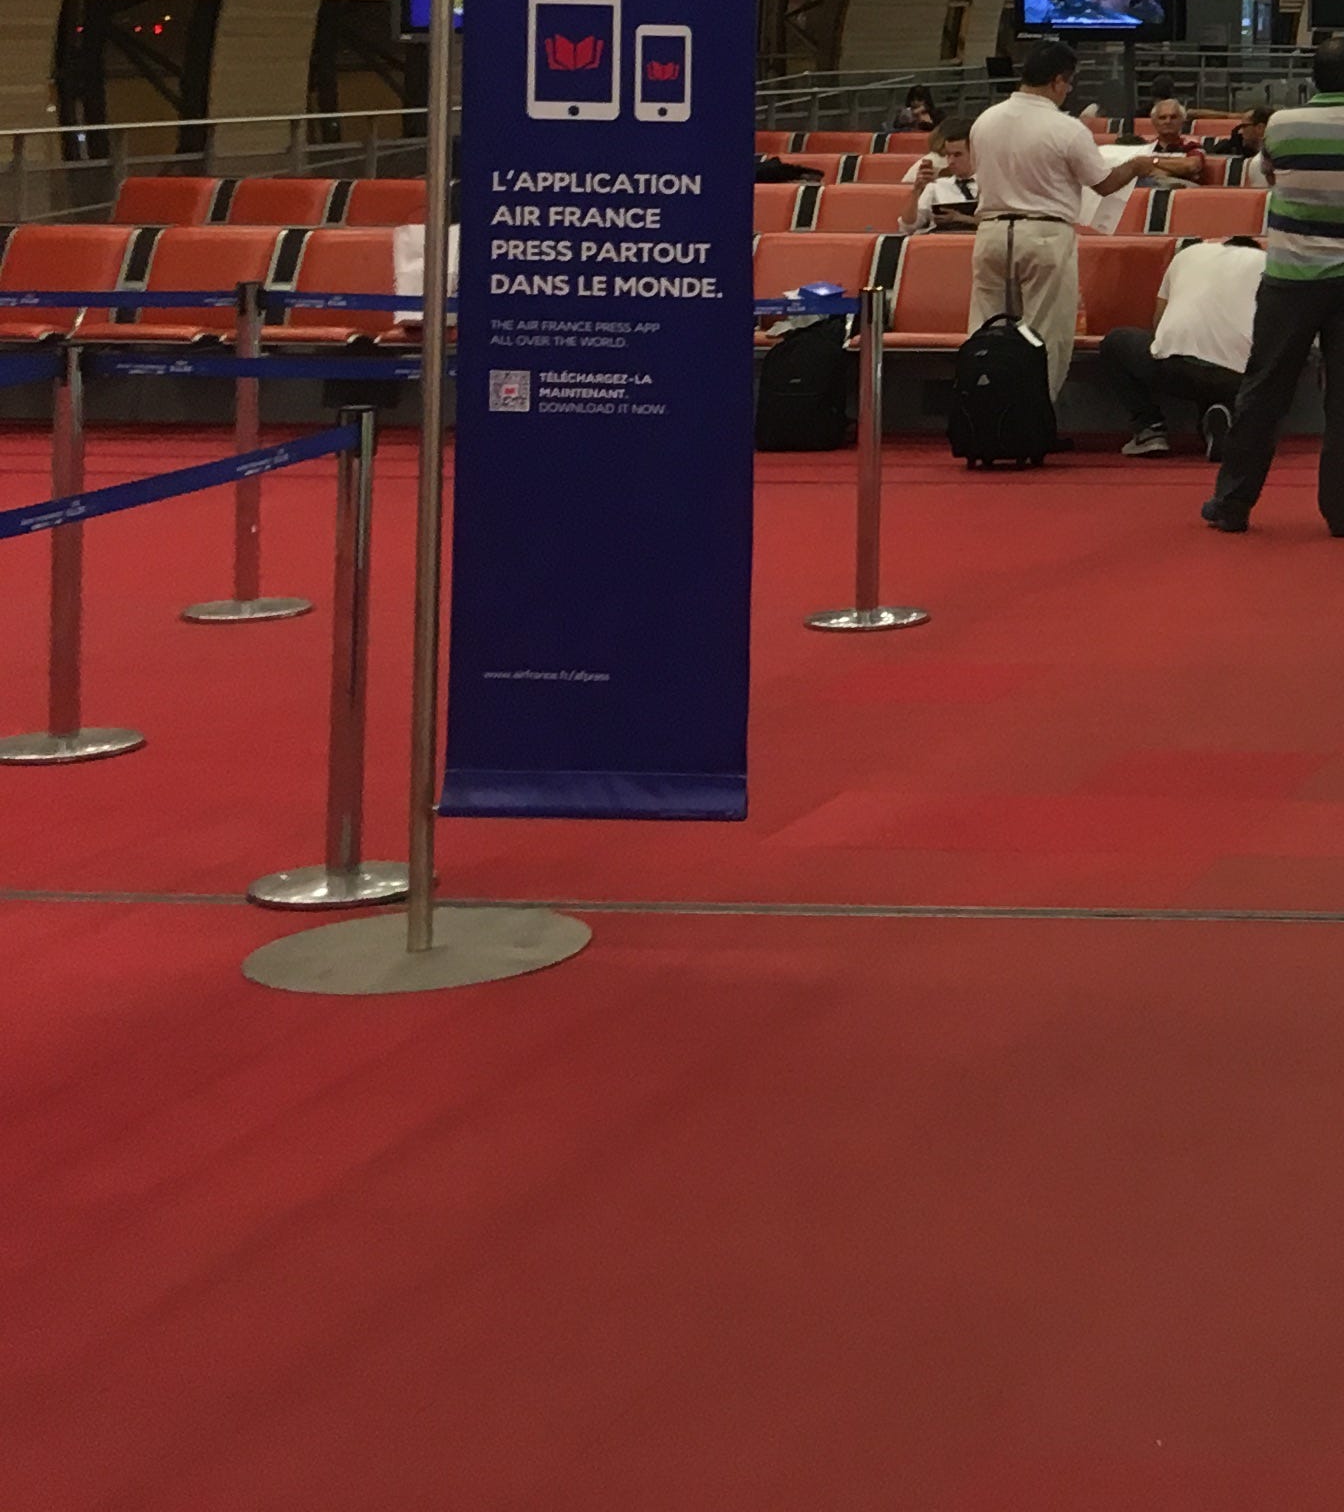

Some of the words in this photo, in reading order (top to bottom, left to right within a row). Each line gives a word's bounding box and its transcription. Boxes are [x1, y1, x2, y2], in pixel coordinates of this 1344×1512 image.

[492, 170, 702, 195] L'APPLICATION
[490, 205, 541, 227] AIR
[548, 206, 661, 228] FRANCE
[491, 240, 573, 262] PRESS
[580, 241, 711, 264] PARTOUT
[490, 274, 570, 296] DANS
[577, 276, 607, 297] LE
[614, 276, 723, 299] MONDE.
[491, 319, 514, 331] THE
[516, 320, 539, 331] AIR
[541, 320, 593, 332] FRANCE
[595, 322, 632, 333] PRESS
[516, 335, 549, 347] OVER
[554, 336, 577, 347] THE
[538, 402, 615, 414] DOWNLOAD
